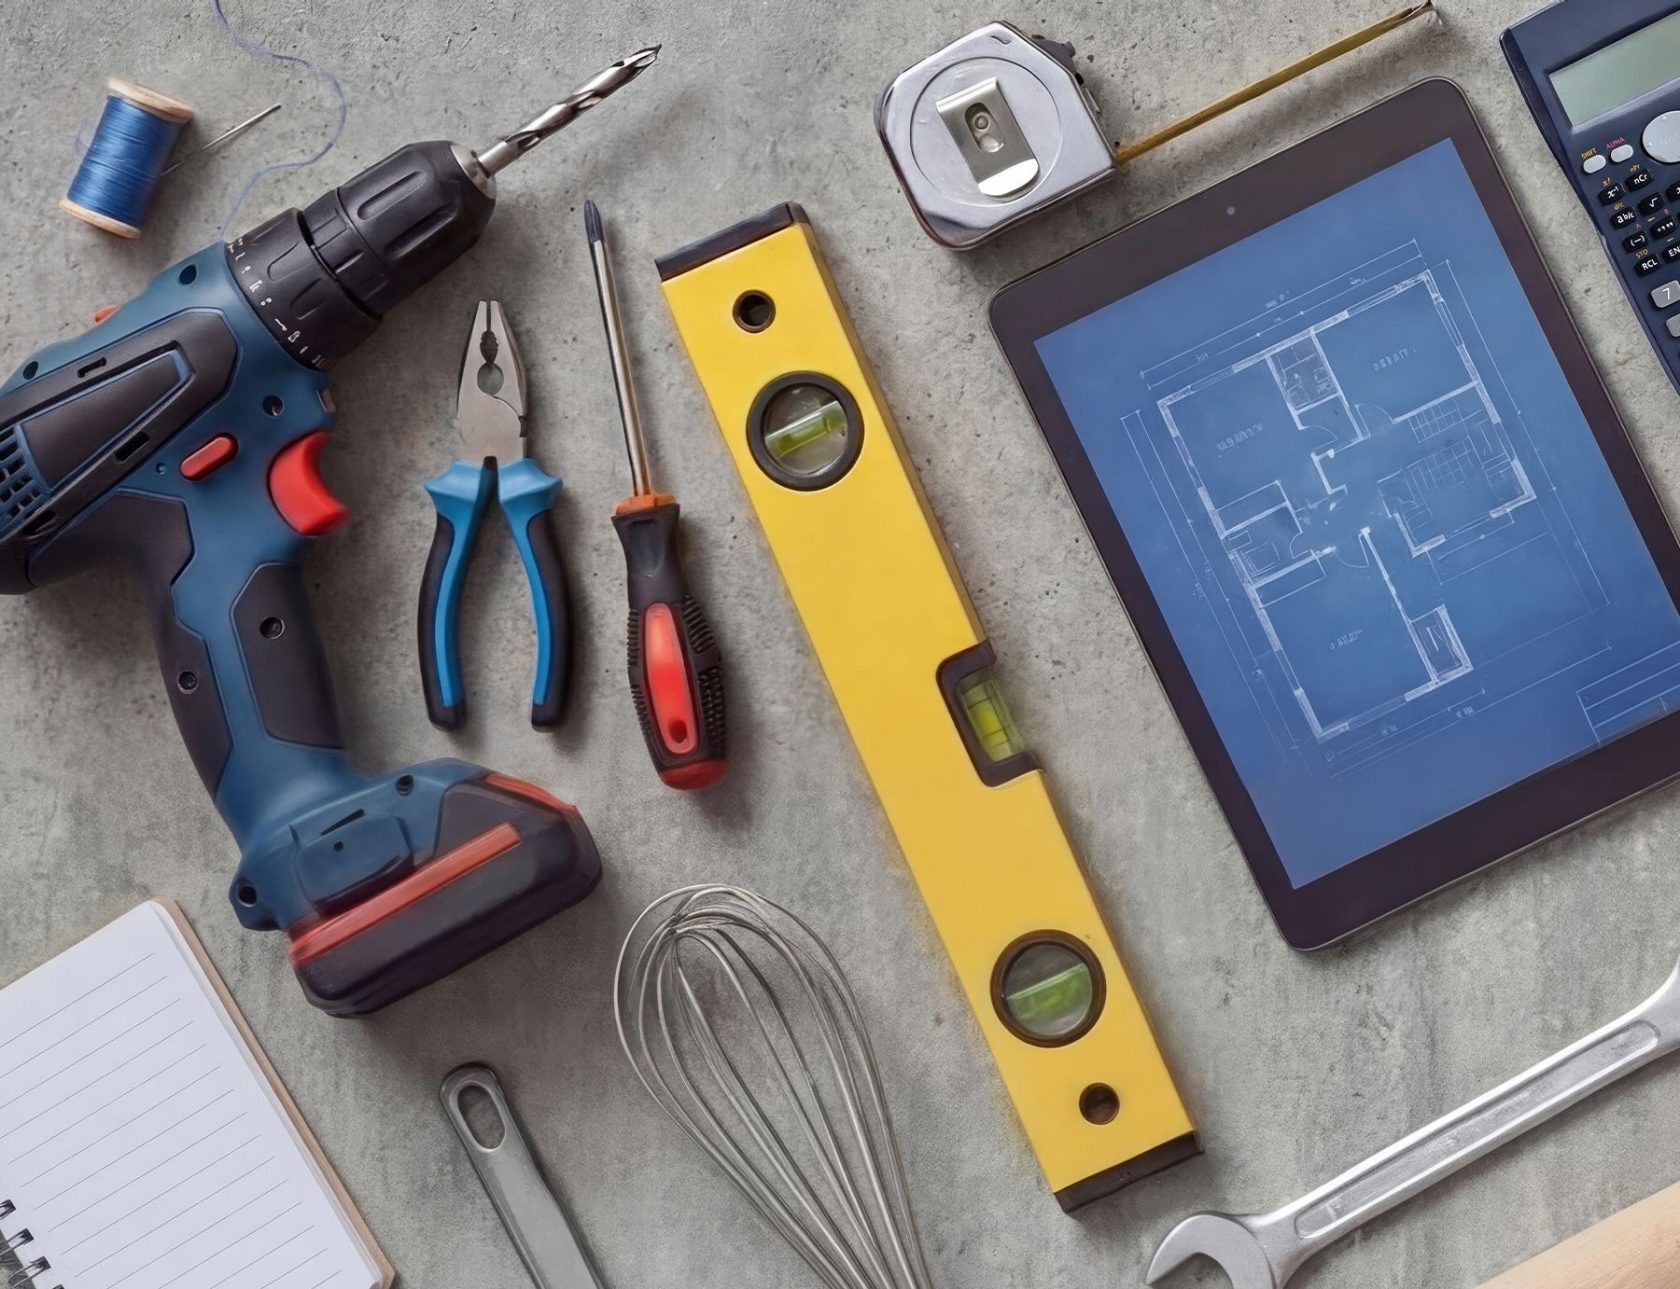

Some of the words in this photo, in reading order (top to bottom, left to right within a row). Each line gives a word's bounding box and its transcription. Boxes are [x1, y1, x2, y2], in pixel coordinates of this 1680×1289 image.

[1605, 137, 1625, 149] ALPHA
[1581, 148, 1597, 160] SHIFT
[1633, 173, 1648, 185] nCr
[1641, 259, 1658, 271] RCL
[1663, 288, 1671, 300] 7
